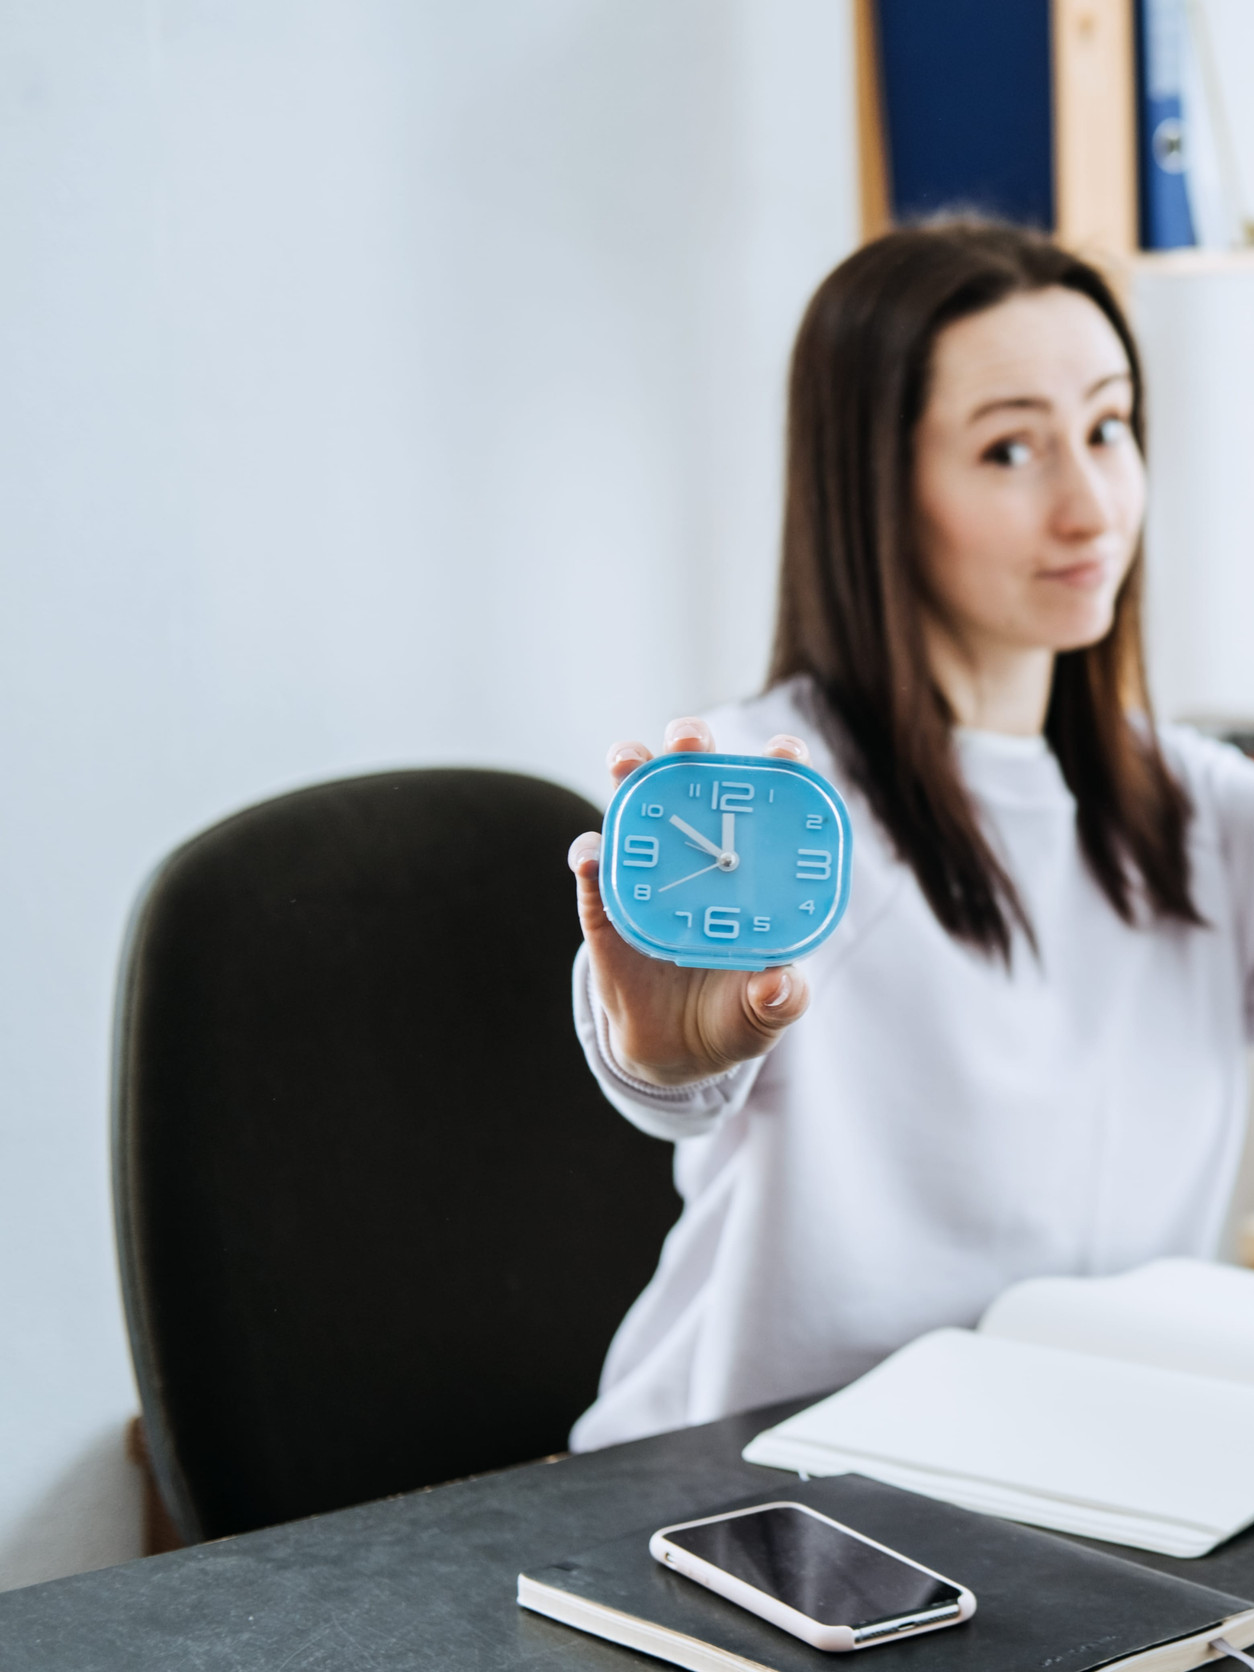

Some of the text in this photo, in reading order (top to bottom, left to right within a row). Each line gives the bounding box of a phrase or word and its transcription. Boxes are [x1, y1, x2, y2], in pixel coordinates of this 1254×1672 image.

[689, 783, 701, 798] 11
[711, 780, 755, 812] 12
[768, 788, 774, 803] 1
[641, 803, 664, 817] 10
[805, 814, 823, 829] 2
[622, 835, 660, 867] 9
[796, 848, 832, 880] 3
[633, 883, 651, 901] 8
[798, 899, 816, 915] 4
[674, 911, 693, 929] 7
[703, 905, 742, 939] 6
[752, 916, 771, 932] 5
